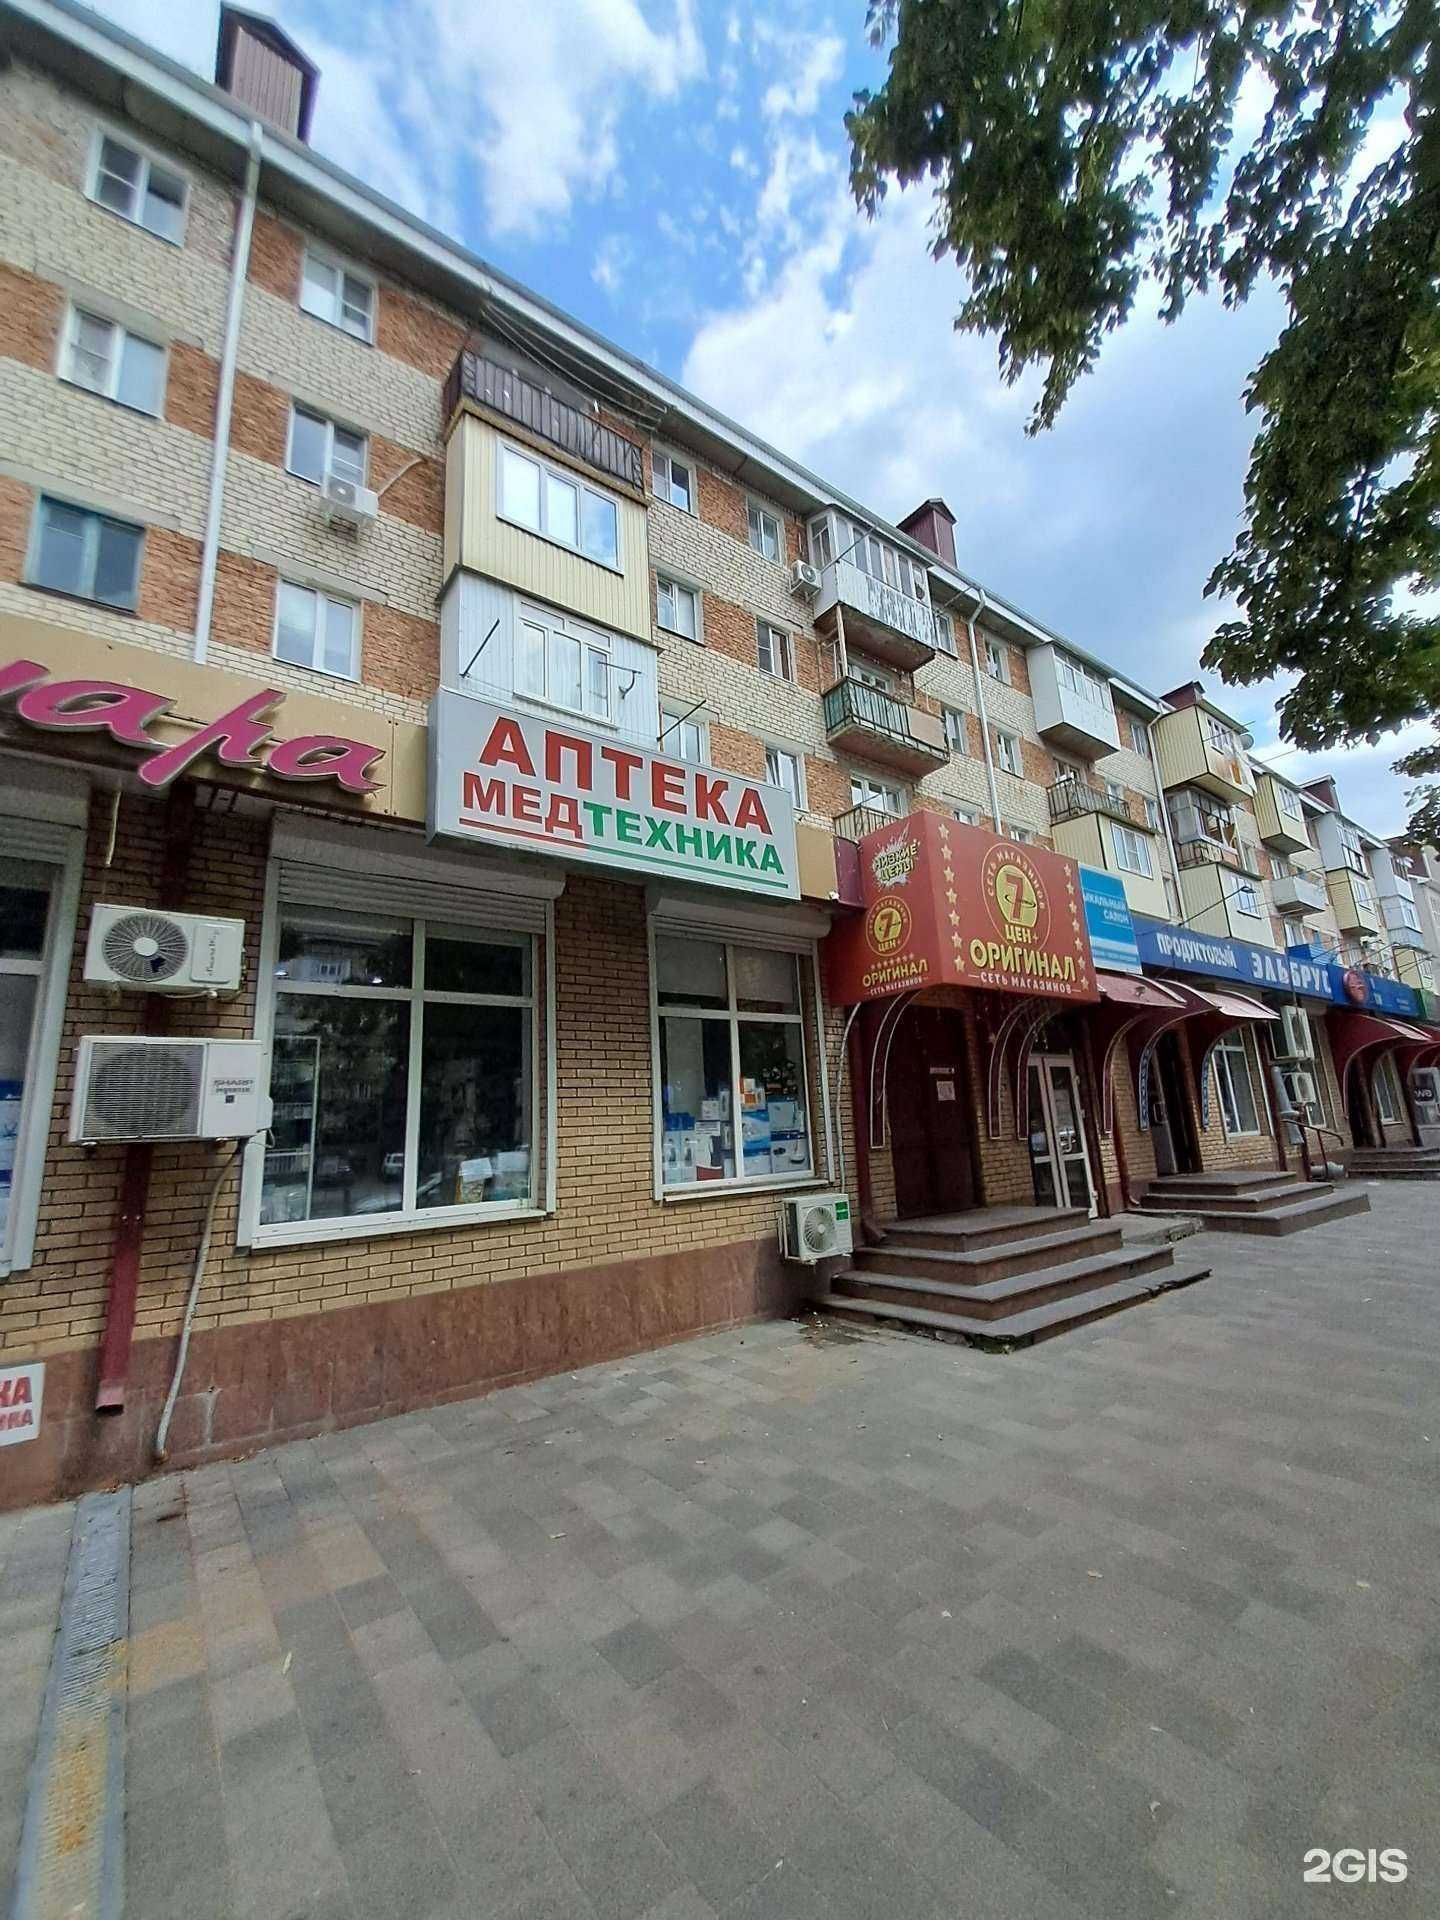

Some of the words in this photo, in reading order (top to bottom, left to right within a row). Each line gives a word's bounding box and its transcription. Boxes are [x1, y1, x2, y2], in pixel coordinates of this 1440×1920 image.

[479, 716, 773, 835] АПТЕКА
[463, 772, 785, 875] МЕДТЕХНИКА
[874, 843, 918, 871] НИЗКИЕ
[880, 858, 914, 881] ЦЕНЫ
[1005, 873, 1024, 922] 7
[880, 911, 893, 940] 7
[969, 938, 1076, 982] ОРИГИНАЛ
[1156, 932, 1237, 969] ПРОДУКТОВЫЙ
[862, 959, 928, 987] ОРИГИНАЛ
[980, 971, 1008, 986] СЕТЬ
[1011, 975, 1072, 994] МАГАЗИНОВ
[1250, 951, 1332, 994] ЭЛЬБРУС
